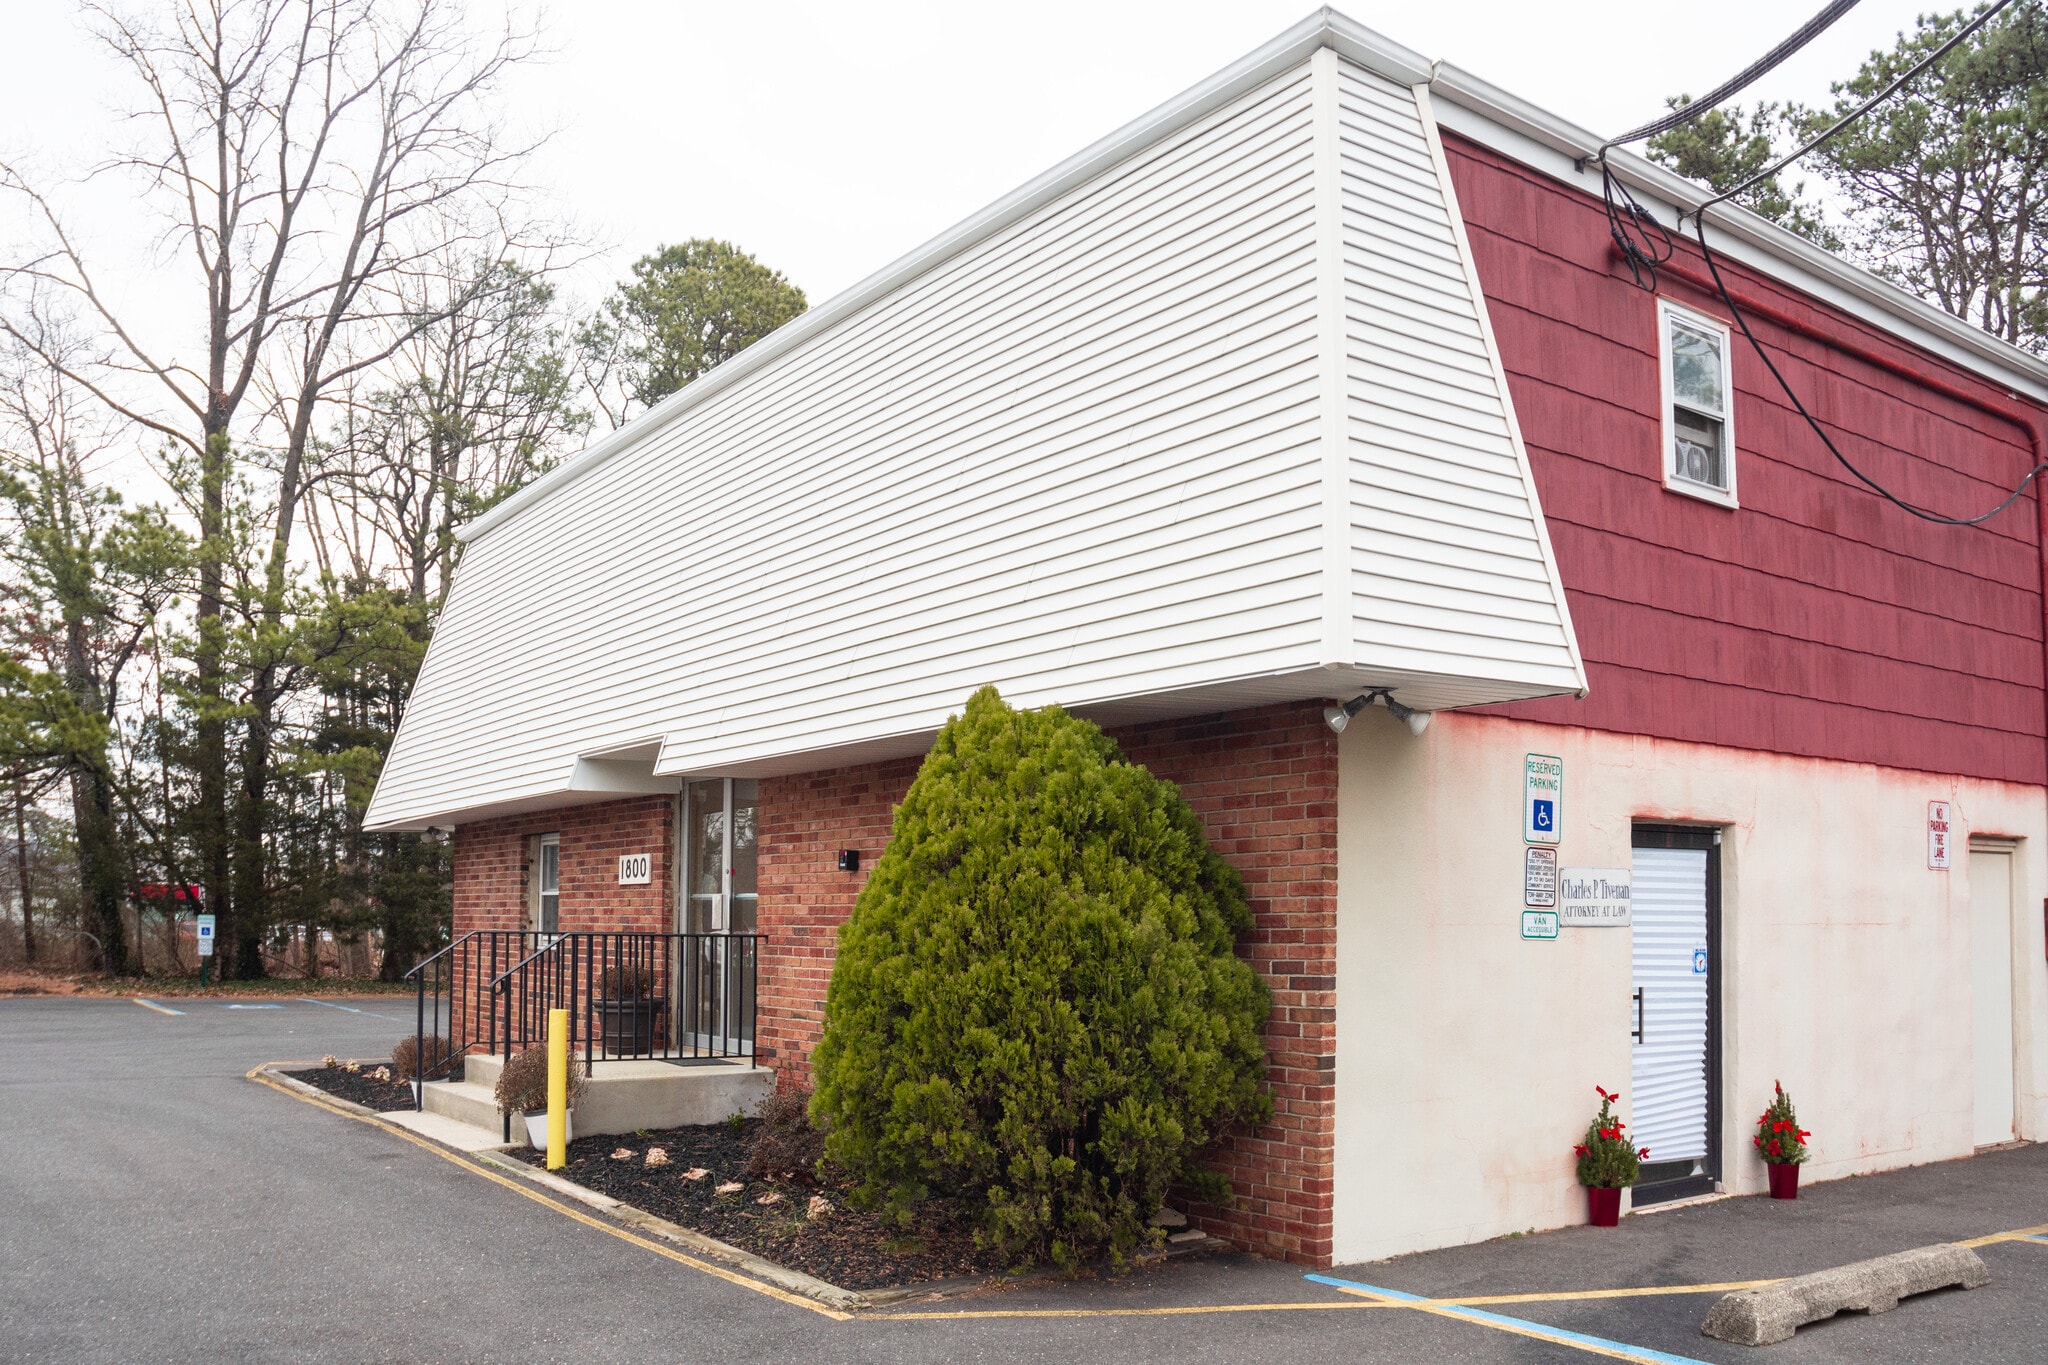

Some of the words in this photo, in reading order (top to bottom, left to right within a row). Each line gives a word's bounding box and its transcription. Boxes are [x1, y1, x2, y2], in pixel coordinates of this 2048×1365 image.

[1528, 761, 1560, 776] RESERVED
[1530, 777, 1558, 791] PARKING
[1930, 820, 1948, 832] PARKING
[1531, 851, 1551, 859] PENALTY
[621, 857, 647, 880] 1800
[1561, 879, 1592, 899] Charles
[1600, 879, 1630, 899] Tivenan
[1564, 905, 1600, 918] ATTORNEY
[1601, 905, 1611, 918] AT
[1612, 905, 1627, 918] LAW
[1533, 916, 1546, 925] VAN
